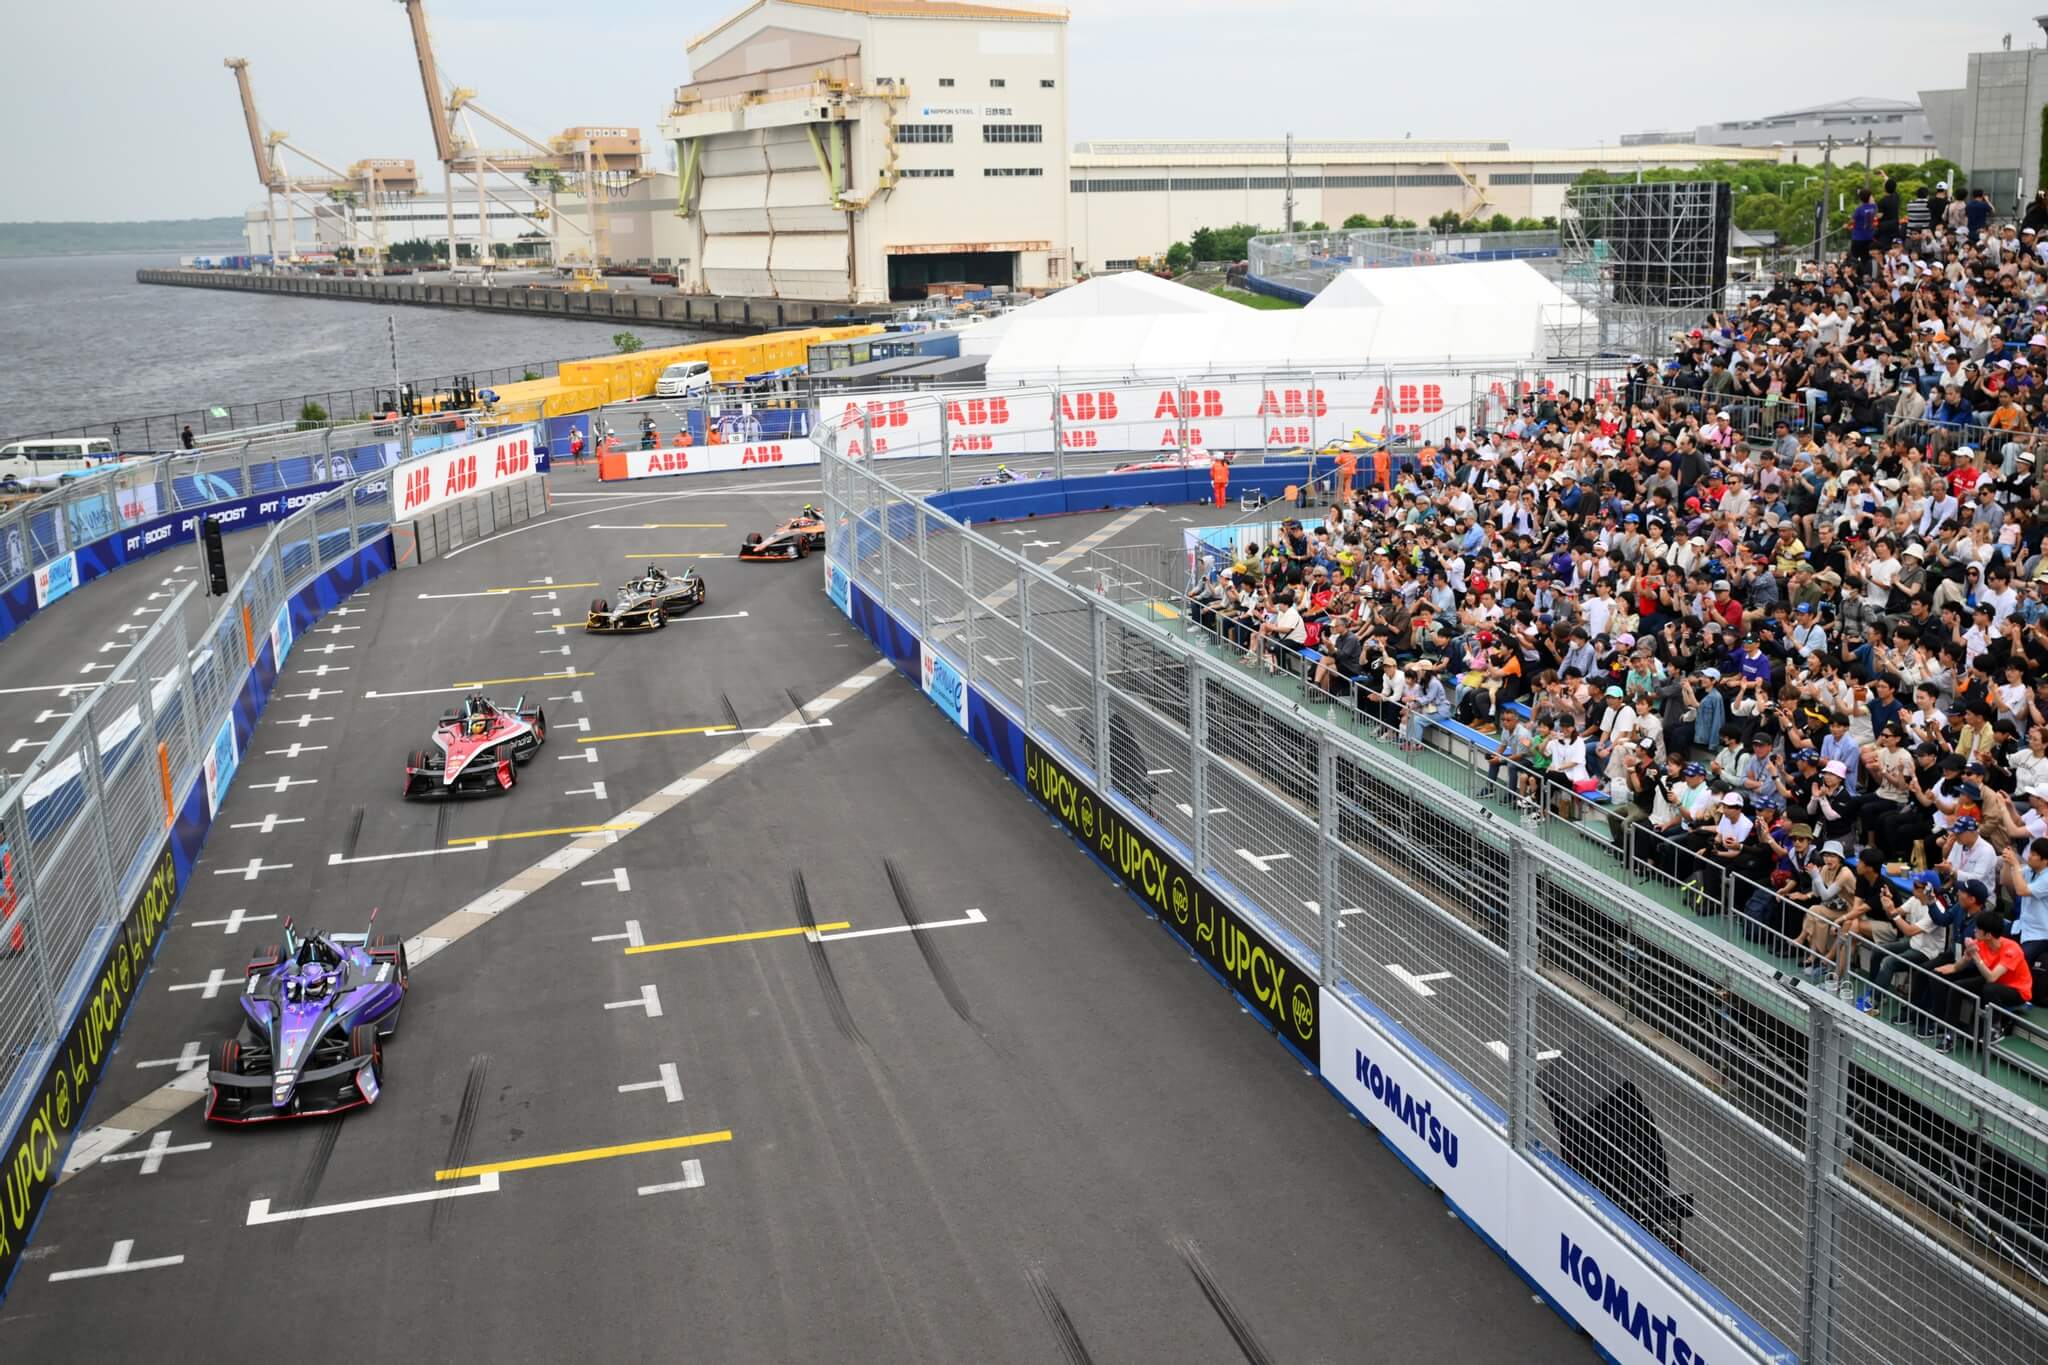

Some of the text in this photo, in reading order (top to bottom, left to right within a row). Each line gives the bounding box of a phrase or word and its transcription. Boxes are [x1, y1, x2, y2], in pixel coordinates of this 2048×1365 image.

[947, 396, 1009, 426] ABB
[1050, 391, 1118, 421] ABB
[1155, 390, 1223, 419] ABB
[1257, 389, 1327, 417] ABB
[1371, 384, 1444, 414] ABB
[842, 400, 908, 430] ABB
[952, 435, 993, 451] ABB
[1268, 426, 1310, 444] ABB
[648, 452, 688, 472] ABB
[742, 445, 783, 465] ABB
[404, 439, 529, 511] ABB ABB ABB
[260, 501, 279, 515] PIT
[127, 524, 172, 552] PIT BOOST
[1040, 757, 1079, 828] UPCX
[1119, 825, 1169, 911] UPCX
[140, 863, 169, 947] UPCX
[1221, 915, 1286, 1021] UPCX
[85, 960, 122, 1065] UPCX
[1355, 1048, 1458, 1169] KOMATSU
[6, 1093, 58, 1230] UPCX
[1560, 1232, 1705, 1365] KOMATS
